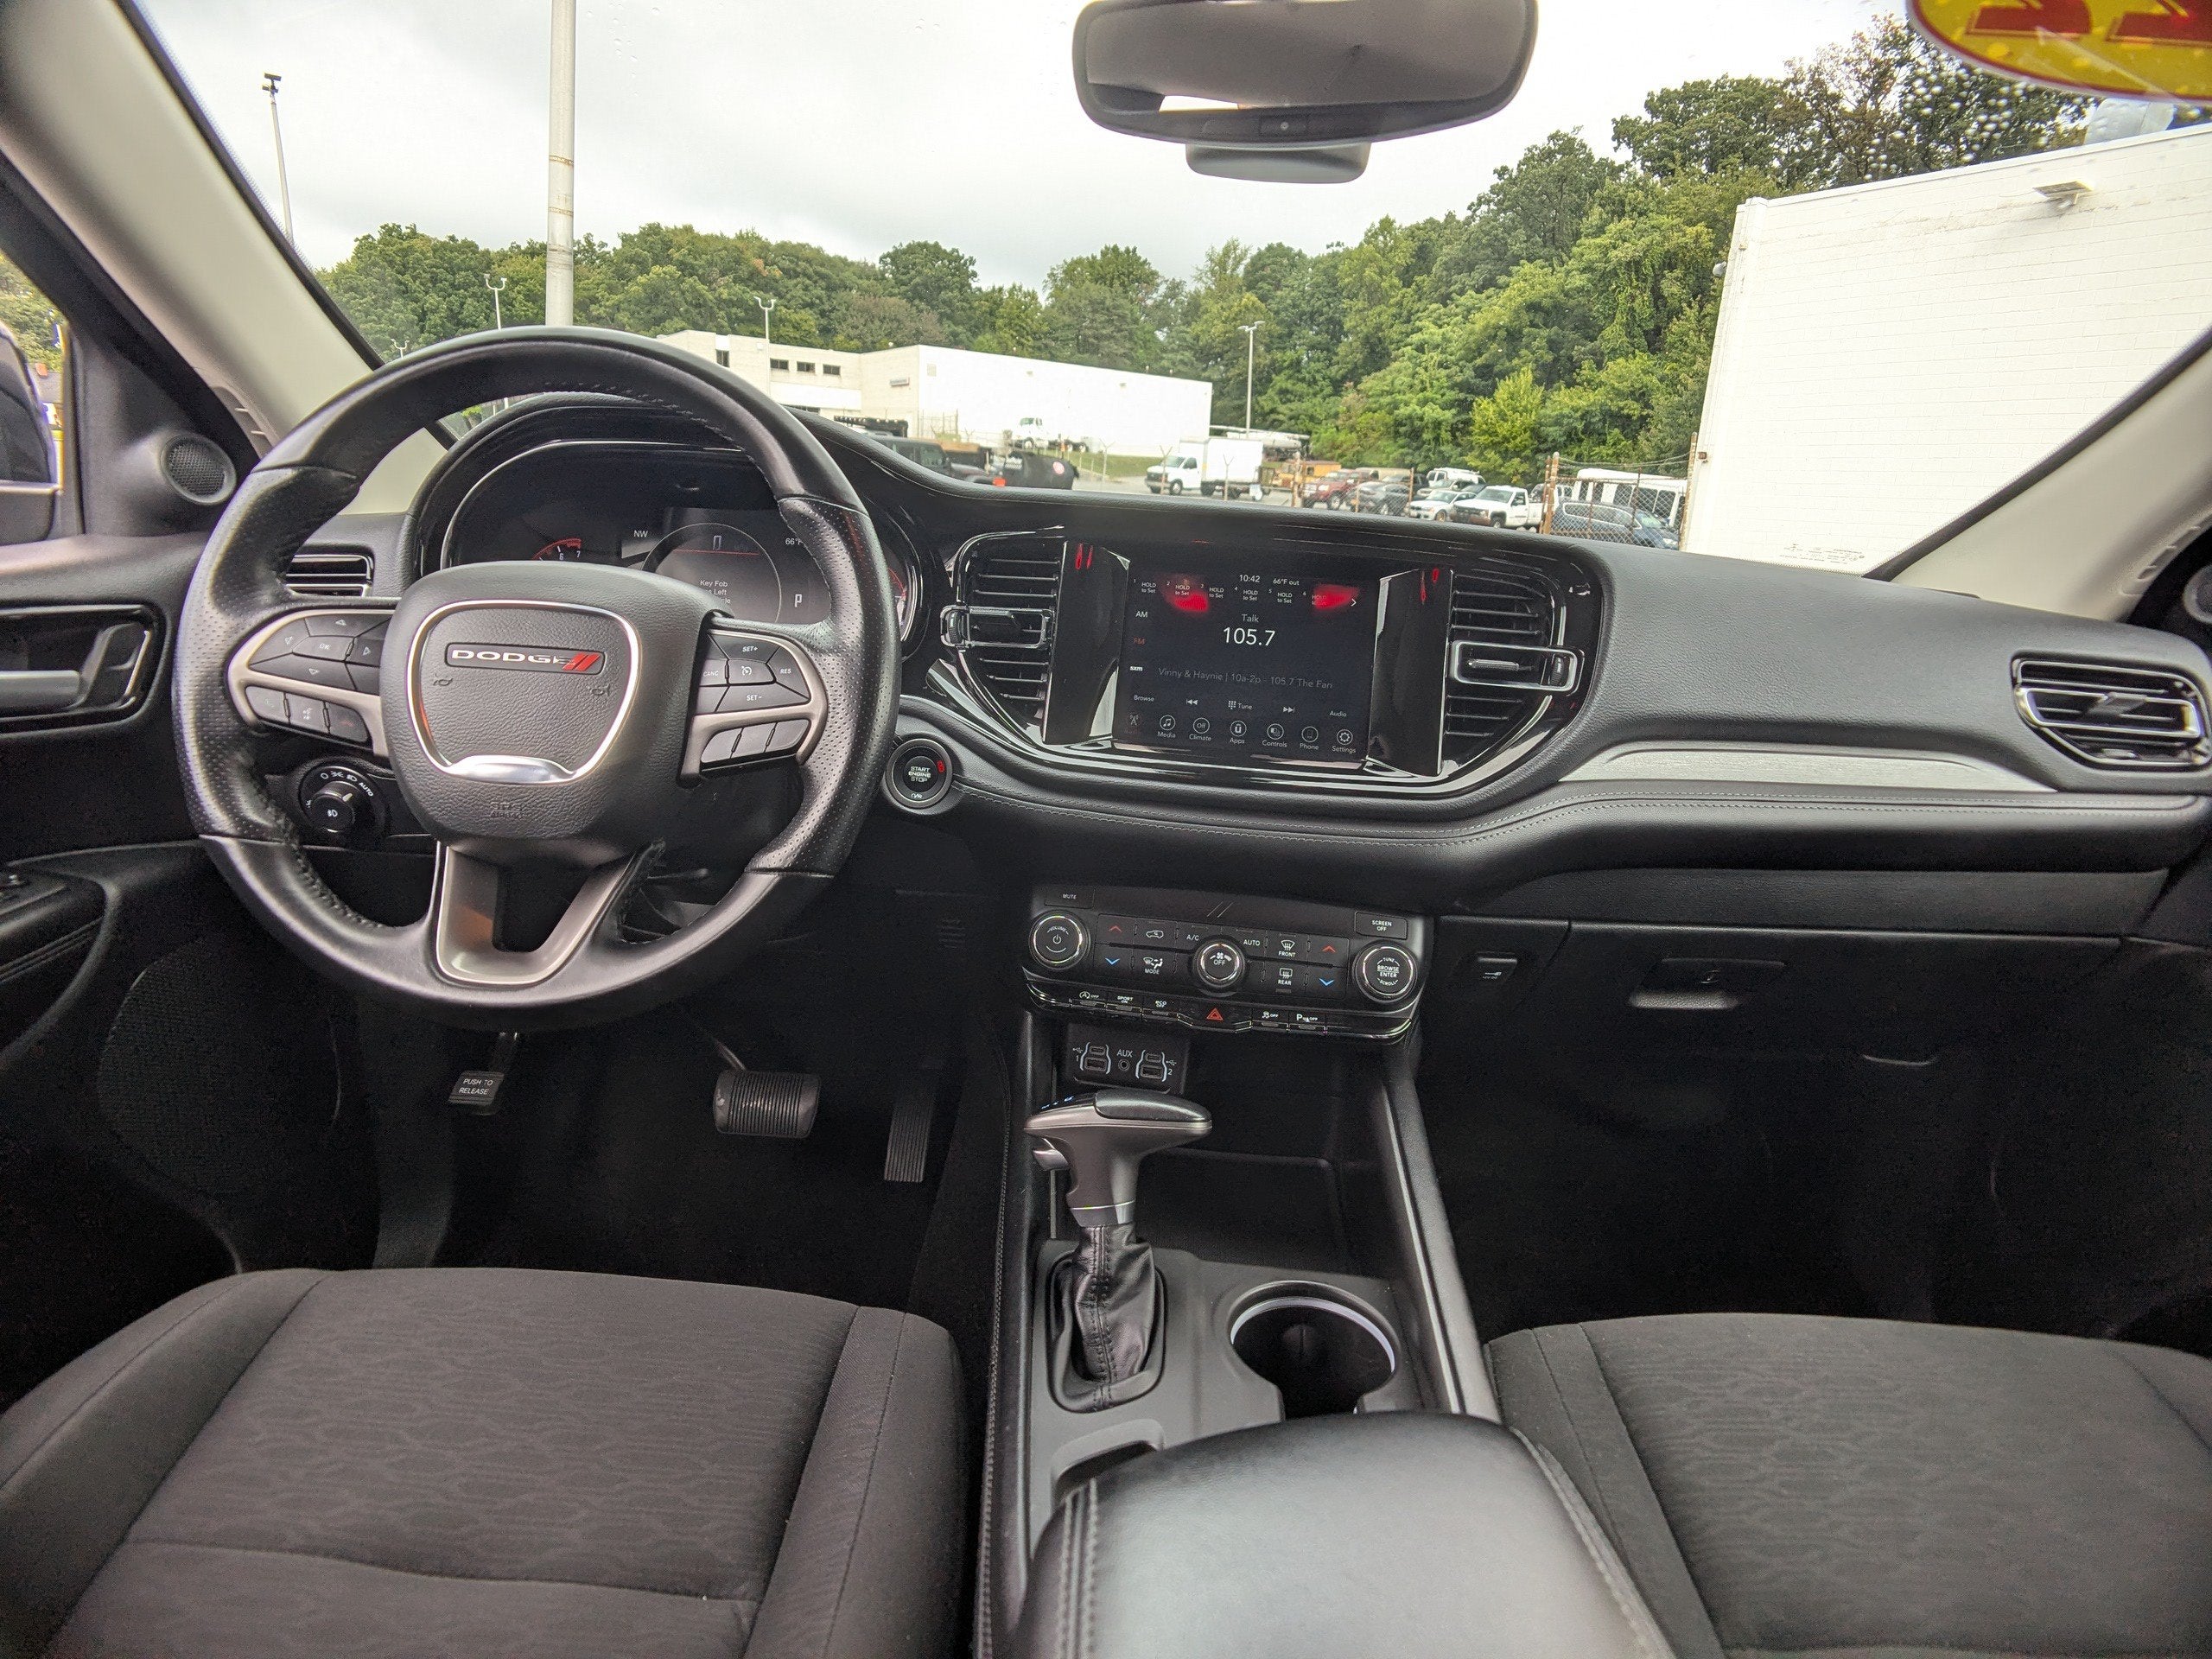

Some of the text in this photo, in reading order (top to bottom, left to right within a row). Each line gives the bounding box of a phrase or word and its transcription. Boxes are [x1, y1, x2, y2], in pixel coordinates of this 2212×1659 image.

[559, 552, 564, 561] 6
[1239, 574, 1261, 583] 10:42
[795, 594, 803, 607] P
[1224, 626, 1275, 646] 105.7
[451, 649, 572, 664] DODGE
[1158, 668, 1182, 679] Vinny
[1193, 671, 1224, 681] Haynie
[1296, 678, 1313, 688] The
[1316, 680, 1333, 690] Fan
[1332, 746, 1356, 754] Settings
[359, 782, 374, 797] AUTO
[1116, 1049, 1133, 1058] AUX
